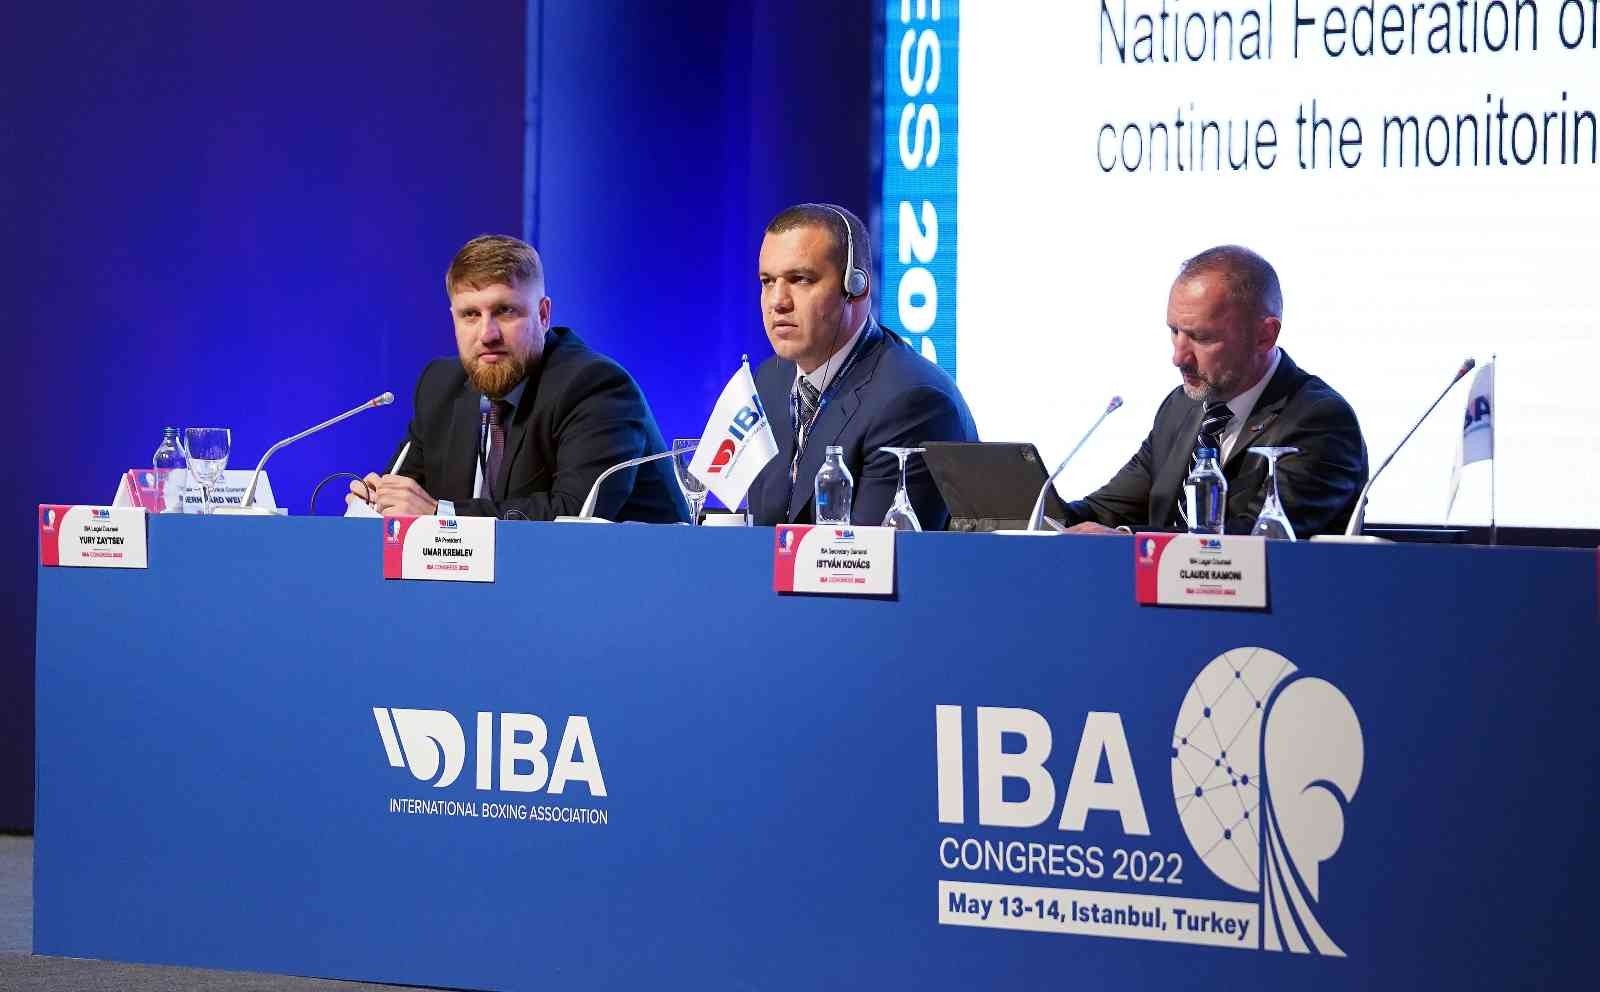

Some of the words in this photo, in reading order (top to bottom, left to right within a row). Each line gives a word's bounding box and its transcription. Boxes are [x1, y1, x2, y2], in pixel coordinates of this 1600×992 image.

[1100, 0, 1272, 64] National
[1294, 0, 1538, 58] Federation
[1097, 101, 1278, 172] continue
[1296, 98, 1362, 169] the
[1383, 91, 1597, 168] monitorin
[80, 536, 96, 544] YURY
[96, 536, 124, 545] ZAYTSEV
[422, 547, 442, 557] UMAR
[443, 548, 473, 557] KREMLEV
[816, 558, 842, 568] ISTVÁN
[842, 558, 870, 569] KOVÁCS
[1180, 570, 1210, 580] CLAUDE
[476, 711, 608, 797] IBA
[936, 704, 1151, 836] IBA
[390, 798, 479, 817] INTERNATIONAL
[482, 803, 527, 820] BOXING
[529, 805, 608, 825] ASSOCIATION
[939, 837, 1104, 879] CONGRESS
[1112, 850, 1183, 885] 2022
[948, 892, 993, 918] May
[1000, 896, 1066, 924] 13-14,
[1071, 901, 1167, 932] Istanbul,
[1173, 909, 1250, 939] Turkey
